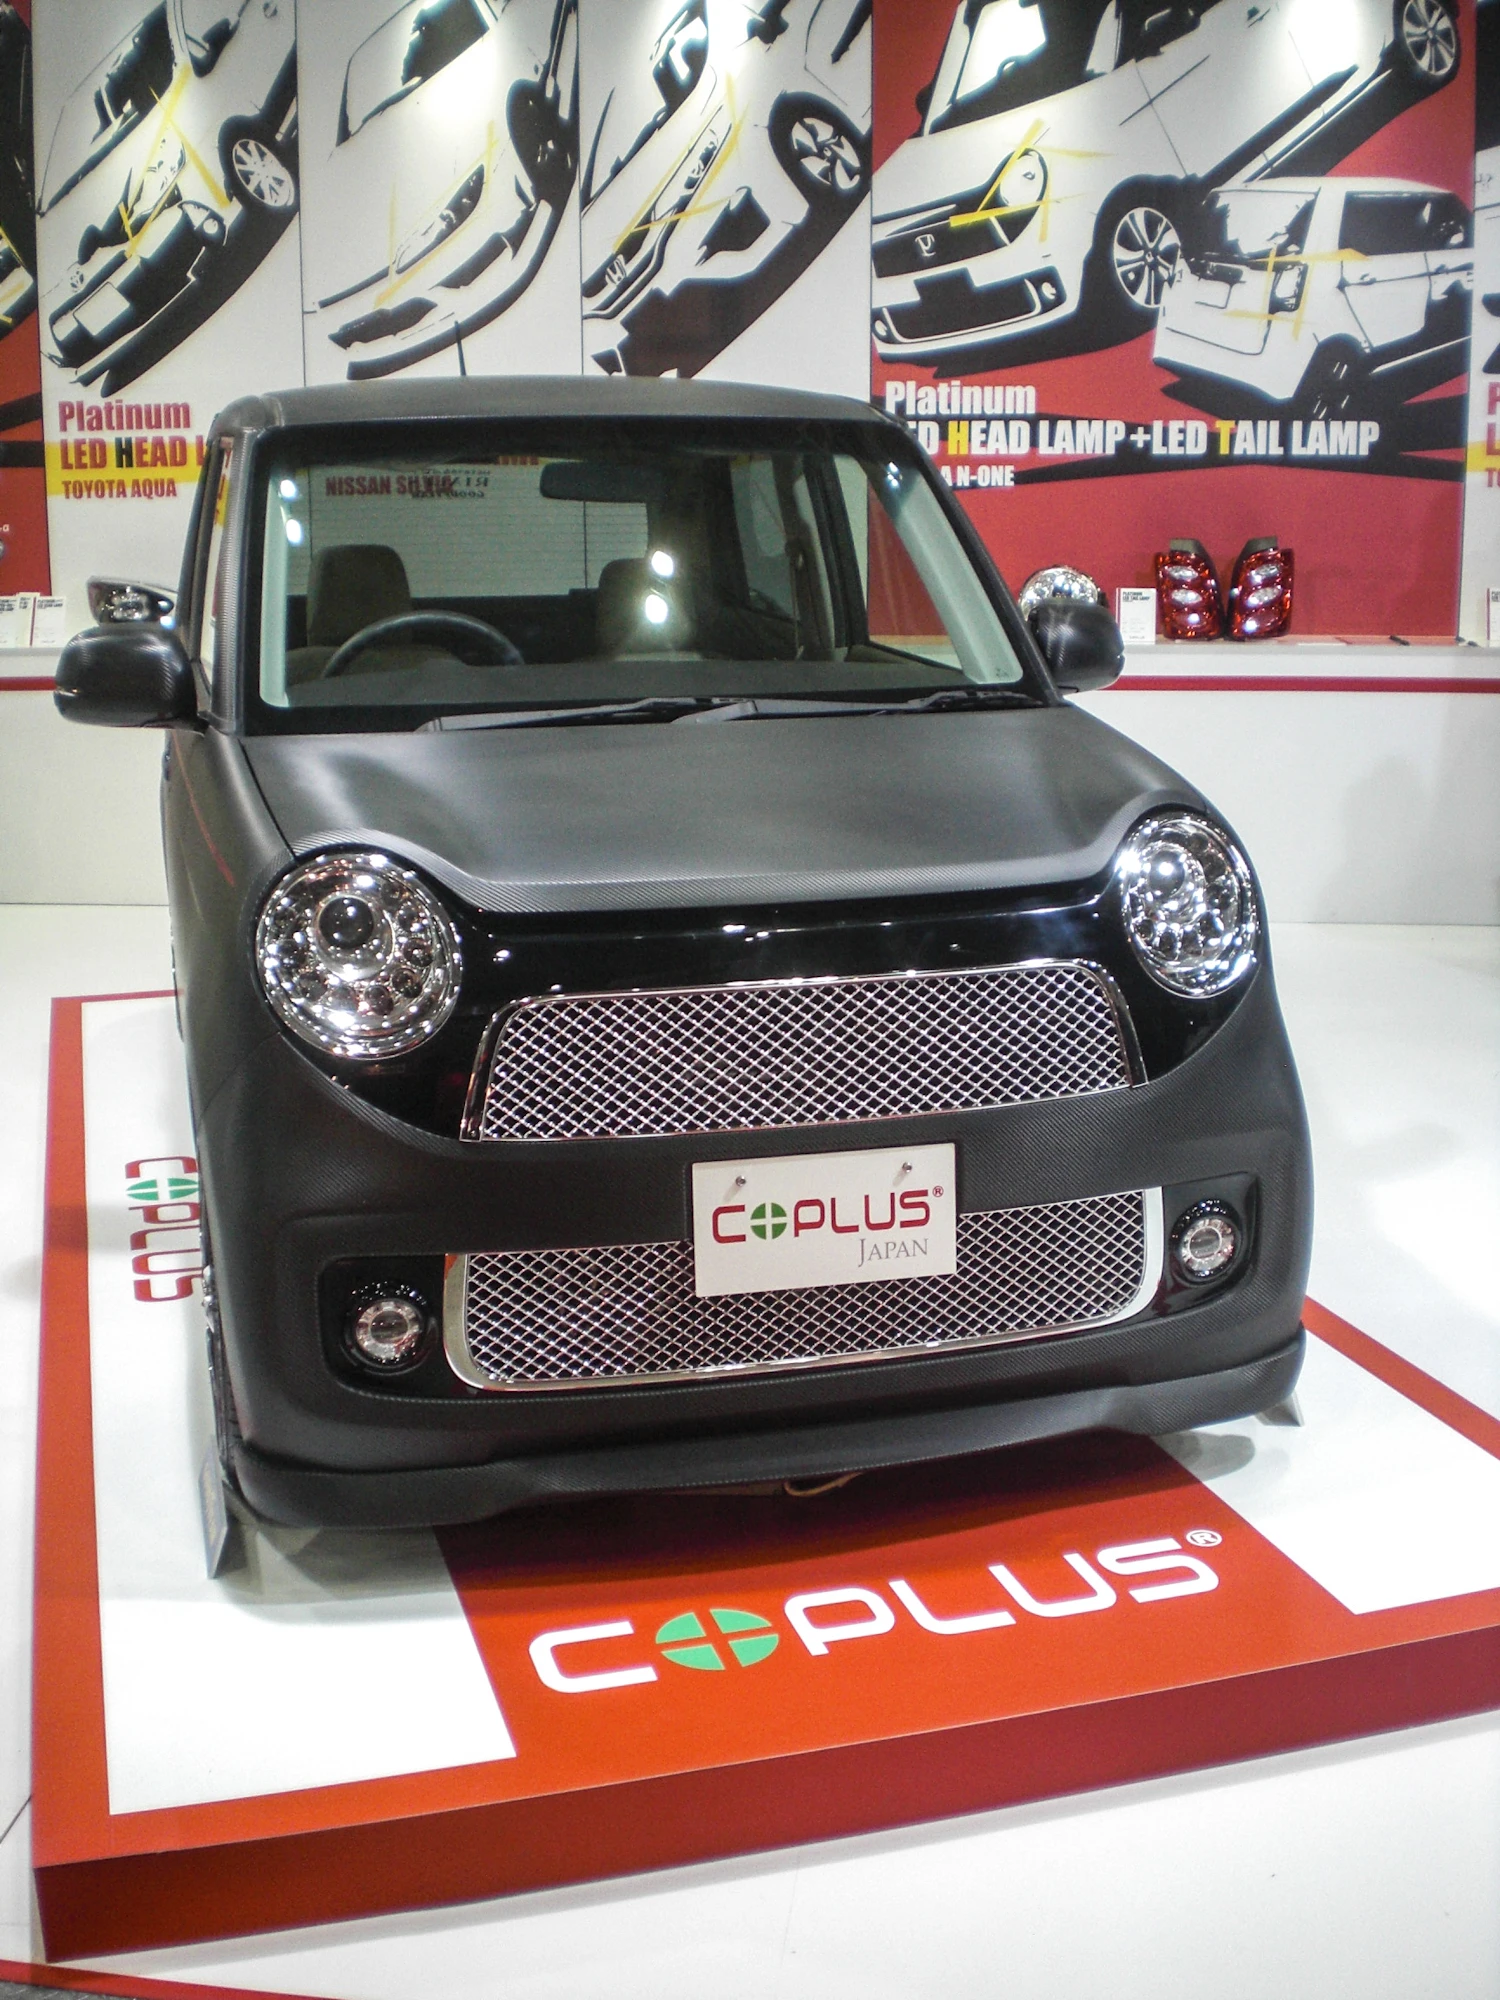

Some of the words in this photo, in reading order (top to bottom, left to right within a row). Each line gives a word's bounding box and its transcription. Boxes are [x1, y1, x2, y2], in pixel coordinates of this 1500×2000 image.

[885, 380, 1036, 415] Platinum
[58, 399, 191, 432] Platinum
[60, 438, 107, 470] LED
[115, 435, 187, 468] HEAD
[948, 420, 1031, 455] HEAD
[1215, 420, 1284, 455] TAIL
[1292, 421, 1380, 456] LAMP
[62, 479, 127, 499] TOYOTA
[131, 477, 177, 499] AQUA
[325, 475, 391, 496] NISSAN
[956, 465, 1014, 487] N-ONE
[858, 1238, 929, 1268] JAPAN
